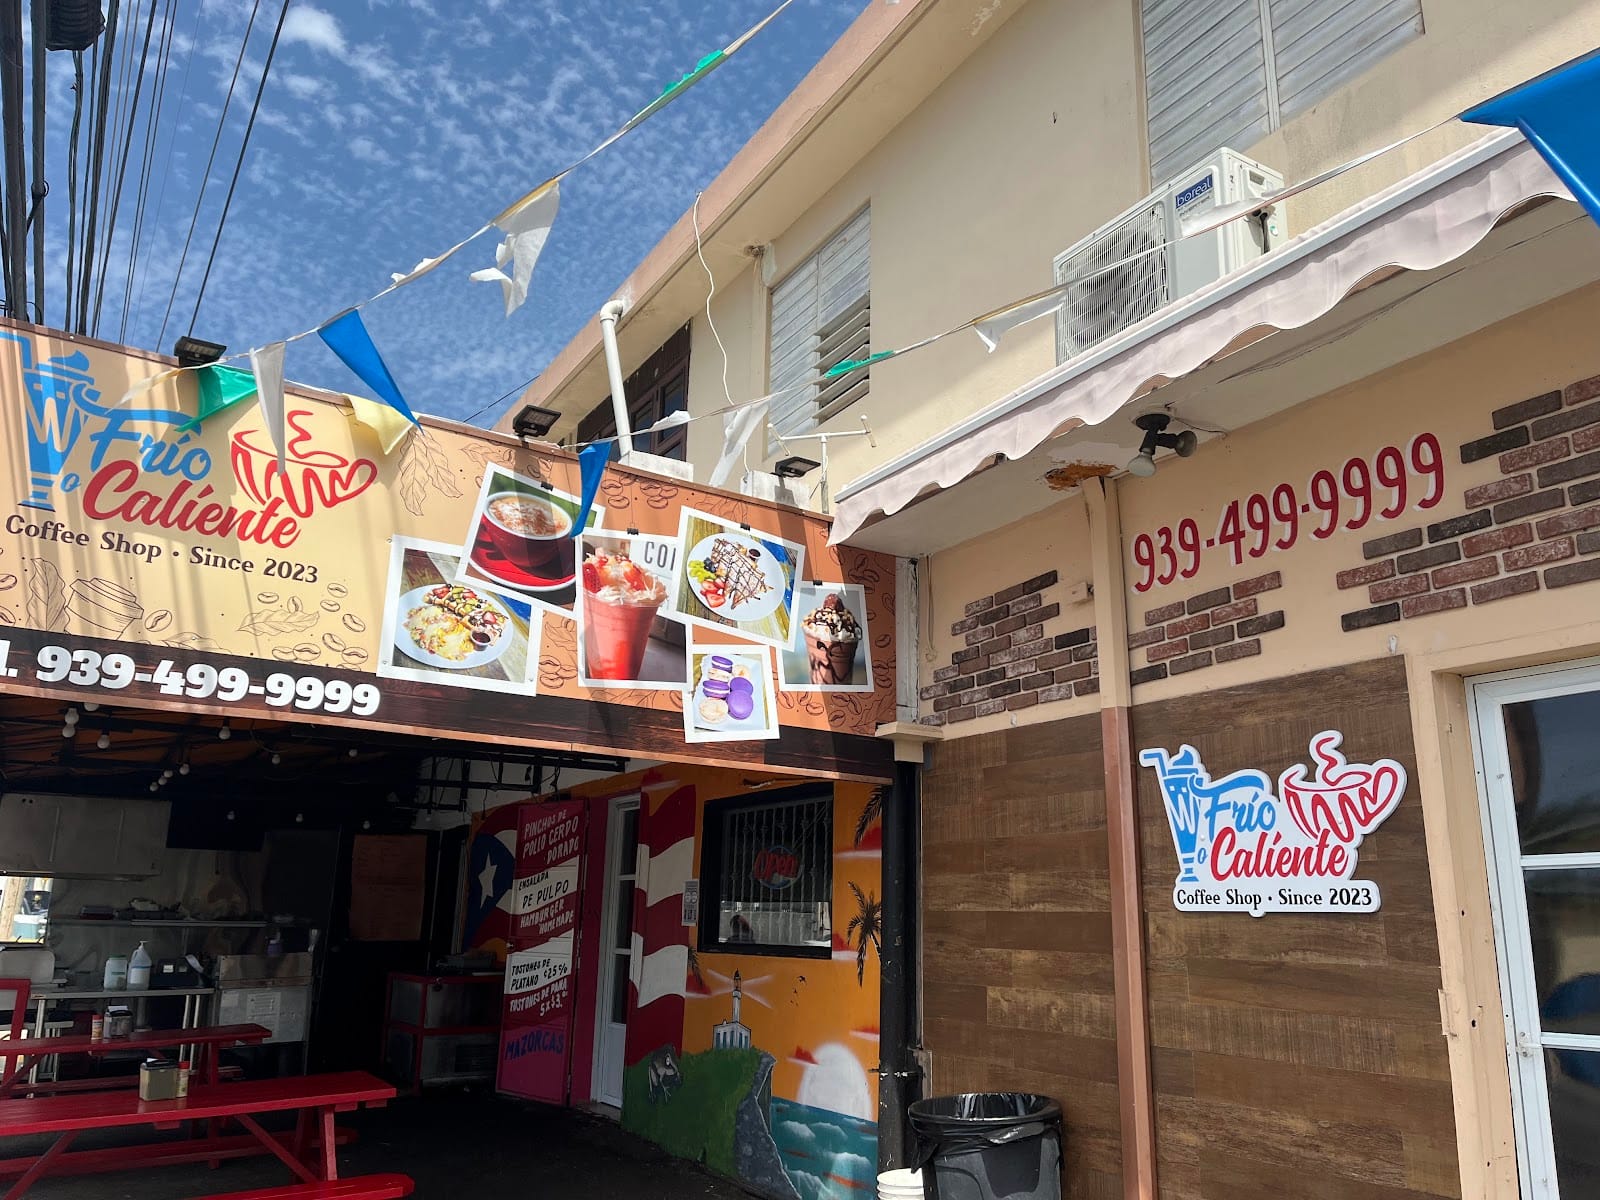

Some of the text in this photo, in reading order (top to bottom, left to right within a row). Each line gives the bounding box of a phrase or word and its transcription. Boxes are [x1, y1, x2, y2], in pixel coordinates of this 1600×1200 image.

[1177, 177, 1210, 206] boreal
[1131, 432, 1445, 595] 939-499-9999
[5, 514, 318, 584] Coffee Shop Since 2023
[644, 541, 676, 571] CO
[36, 645, 381, 716] 939-499-9999
[1189, 774, 1276, 842] Frío
[523, 816, 579, 859] POLLO CERDO
[524, 809, 567, 840] PINCHOS DE
[518, 871, 549, 891] ENSALADA
[522, 879, 569, 909] DE PULPO
[520, 898, 564, 929] HAMBURGER
[1177, 887, 1372, 910] Coffee Shop Since 2023
[511, 958, 551, 976] TOSTONES DE
[510, 974, 539, 991] PLATANO
[510, 992, 540, 1012] TOSTONES
[541, 985, 551, 999] DE
[505, 1031, 564, 1061] MAZORCAS
